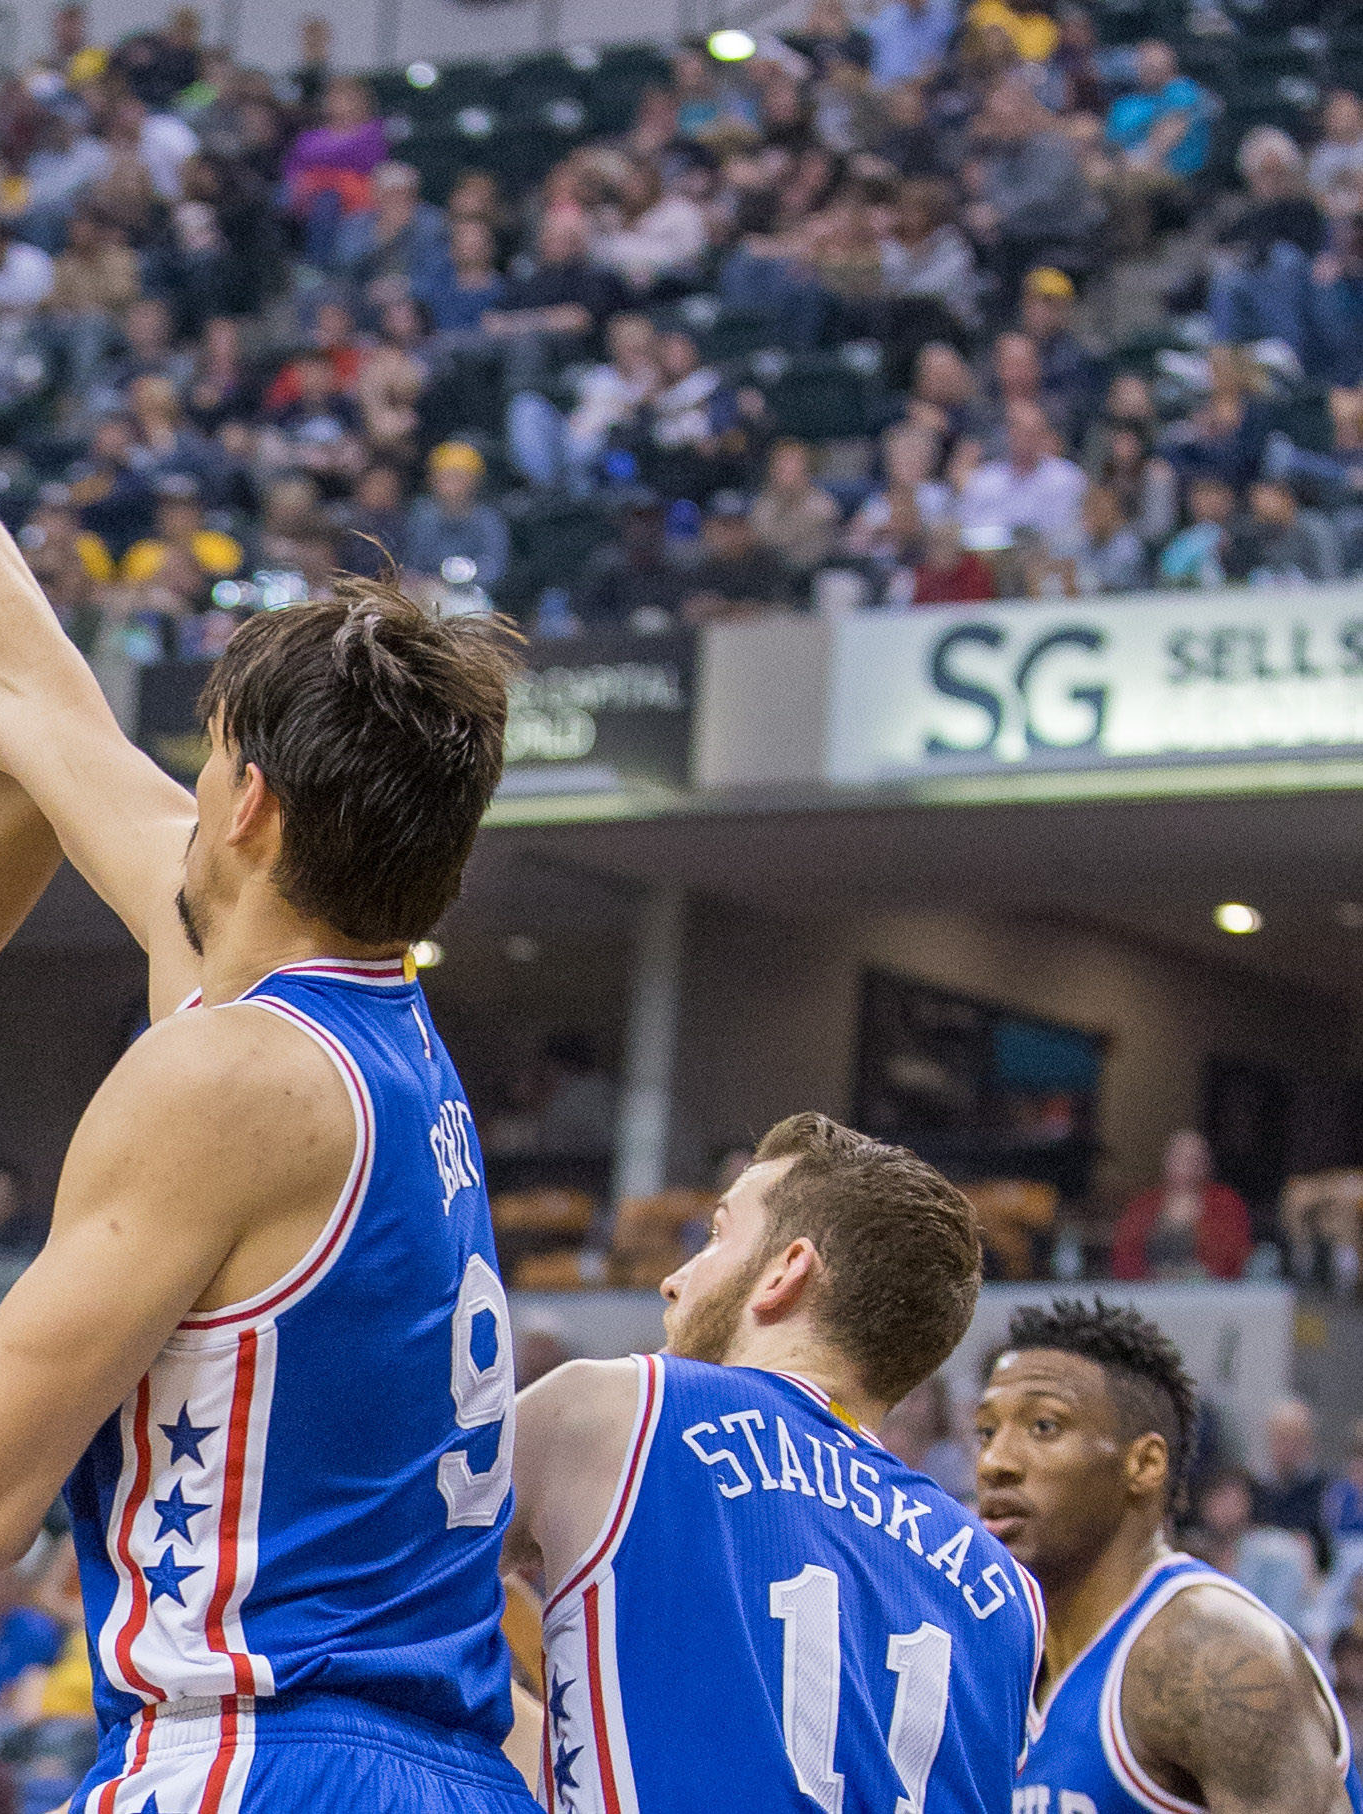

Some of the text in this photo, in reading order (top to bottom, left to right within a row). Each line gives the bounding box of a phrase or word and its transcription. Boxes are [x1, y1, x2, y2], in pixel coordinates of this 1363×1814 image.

[923, 621, 1110, 757] SG
[438, 1252, 516, 1530] 9
[681, 1408, 1017, 1621] STAUSKAS
[769, 1563, 952, 1814] 11
